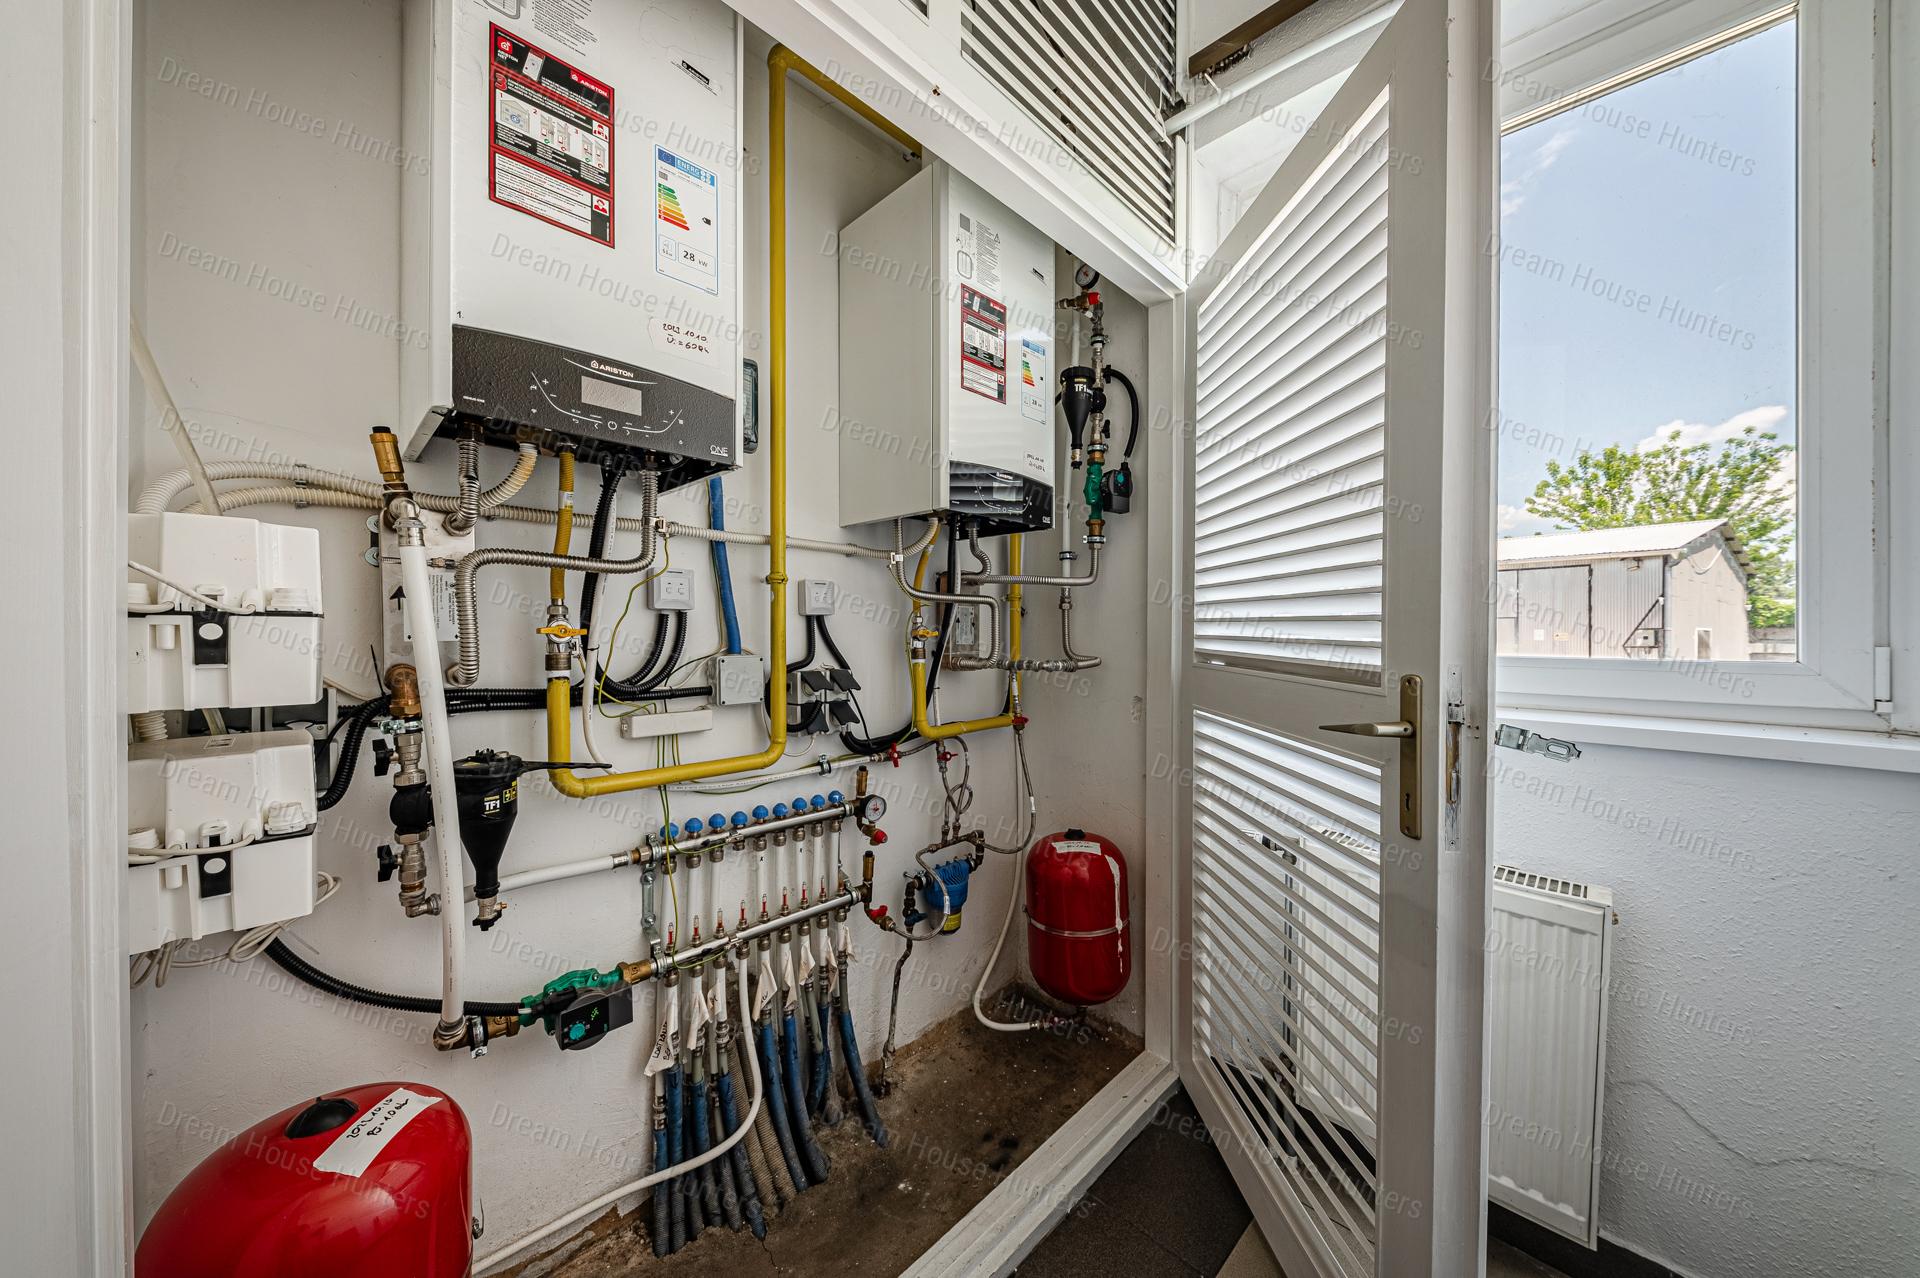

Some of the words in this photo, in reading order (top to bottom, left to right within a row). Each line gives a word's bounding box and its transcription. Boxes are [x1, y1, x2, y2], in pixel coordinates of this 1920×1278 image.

[683, 250, 695, 262] 28
[599, 364, 634, 378] ARISTON
[1074, 383, 1087, 393] TF1
[710, 444, 729, 455] ONE
[484, 799, 500, 811] TF1
